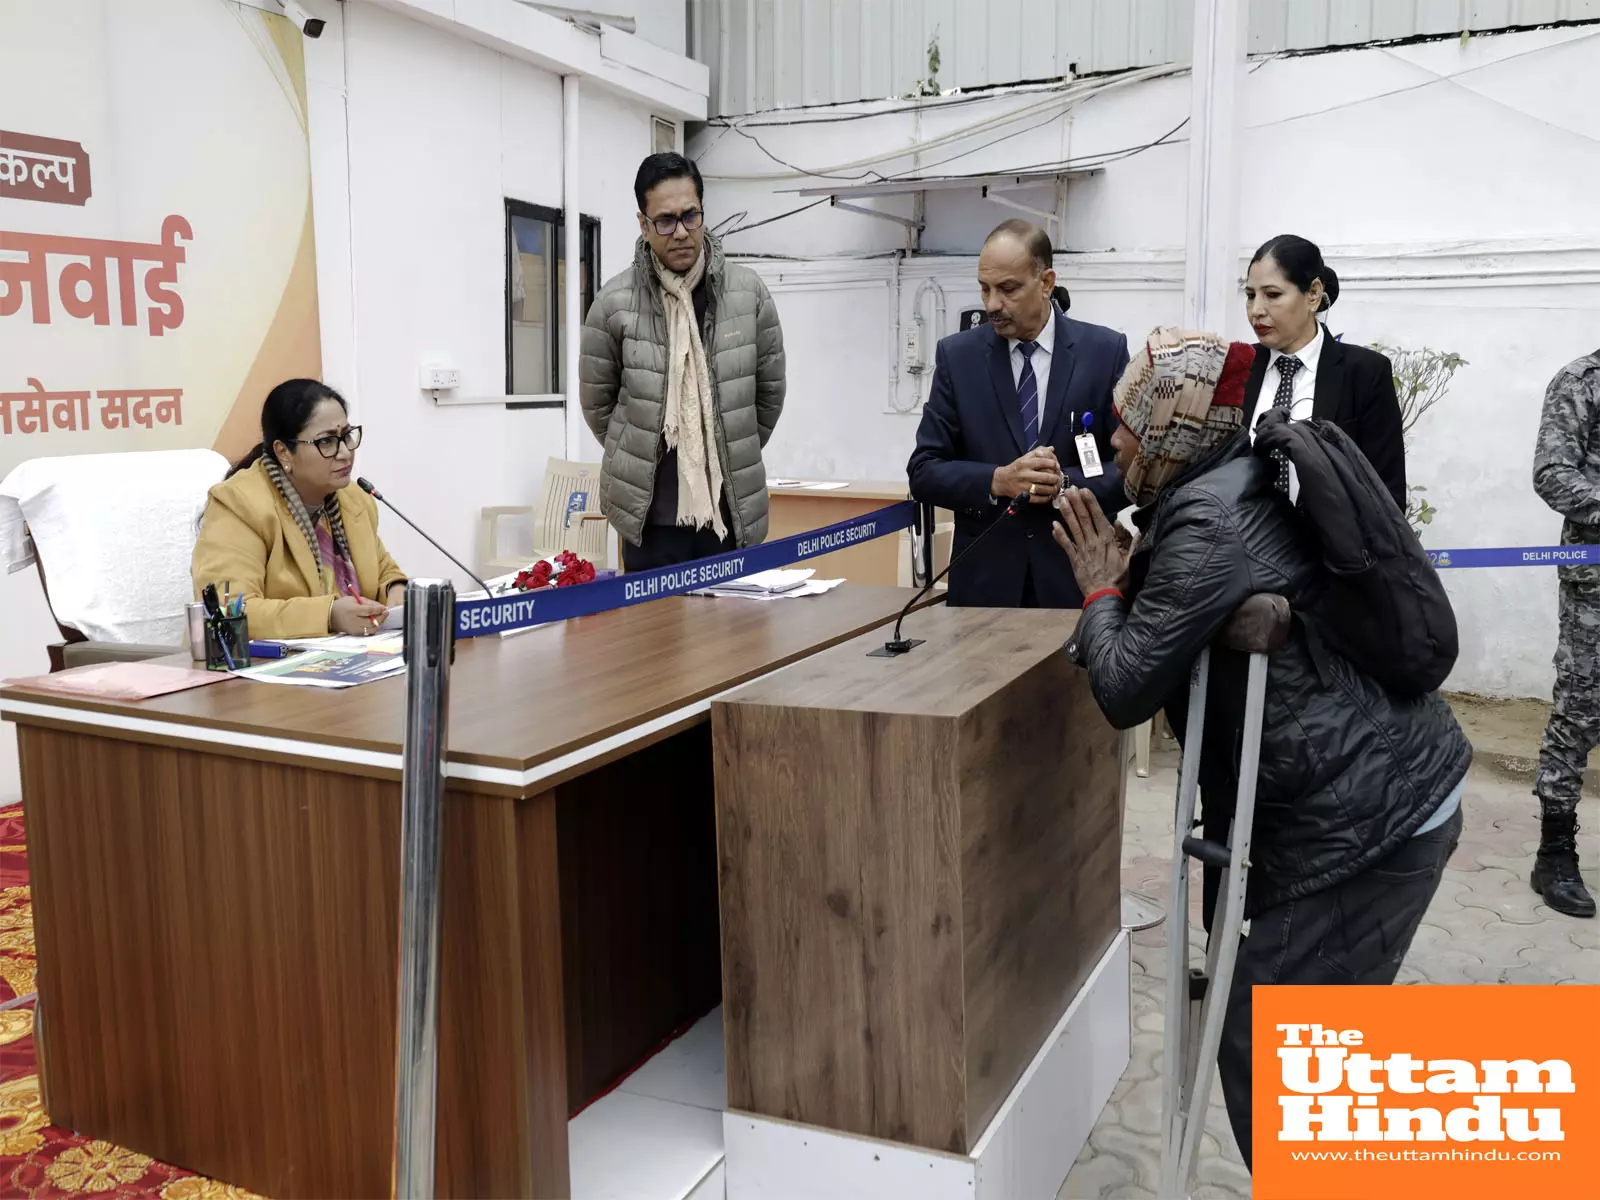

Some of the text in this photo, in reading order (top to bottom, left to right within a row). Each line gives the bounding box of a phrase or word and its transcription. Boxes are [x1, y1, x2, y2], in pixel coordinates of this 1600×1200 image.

[97, 388, 183, 430] सदन
[797, 521, 877, 557] DELHI POLICE SECURITY
[1522, 551, 1551, 561] DELHI
[1552, 550, 1588, 560] POLICE
[624, 557, 745, 600] DELHI POLICE SECURITY
[460, 599, 535, 631] SECURITY
